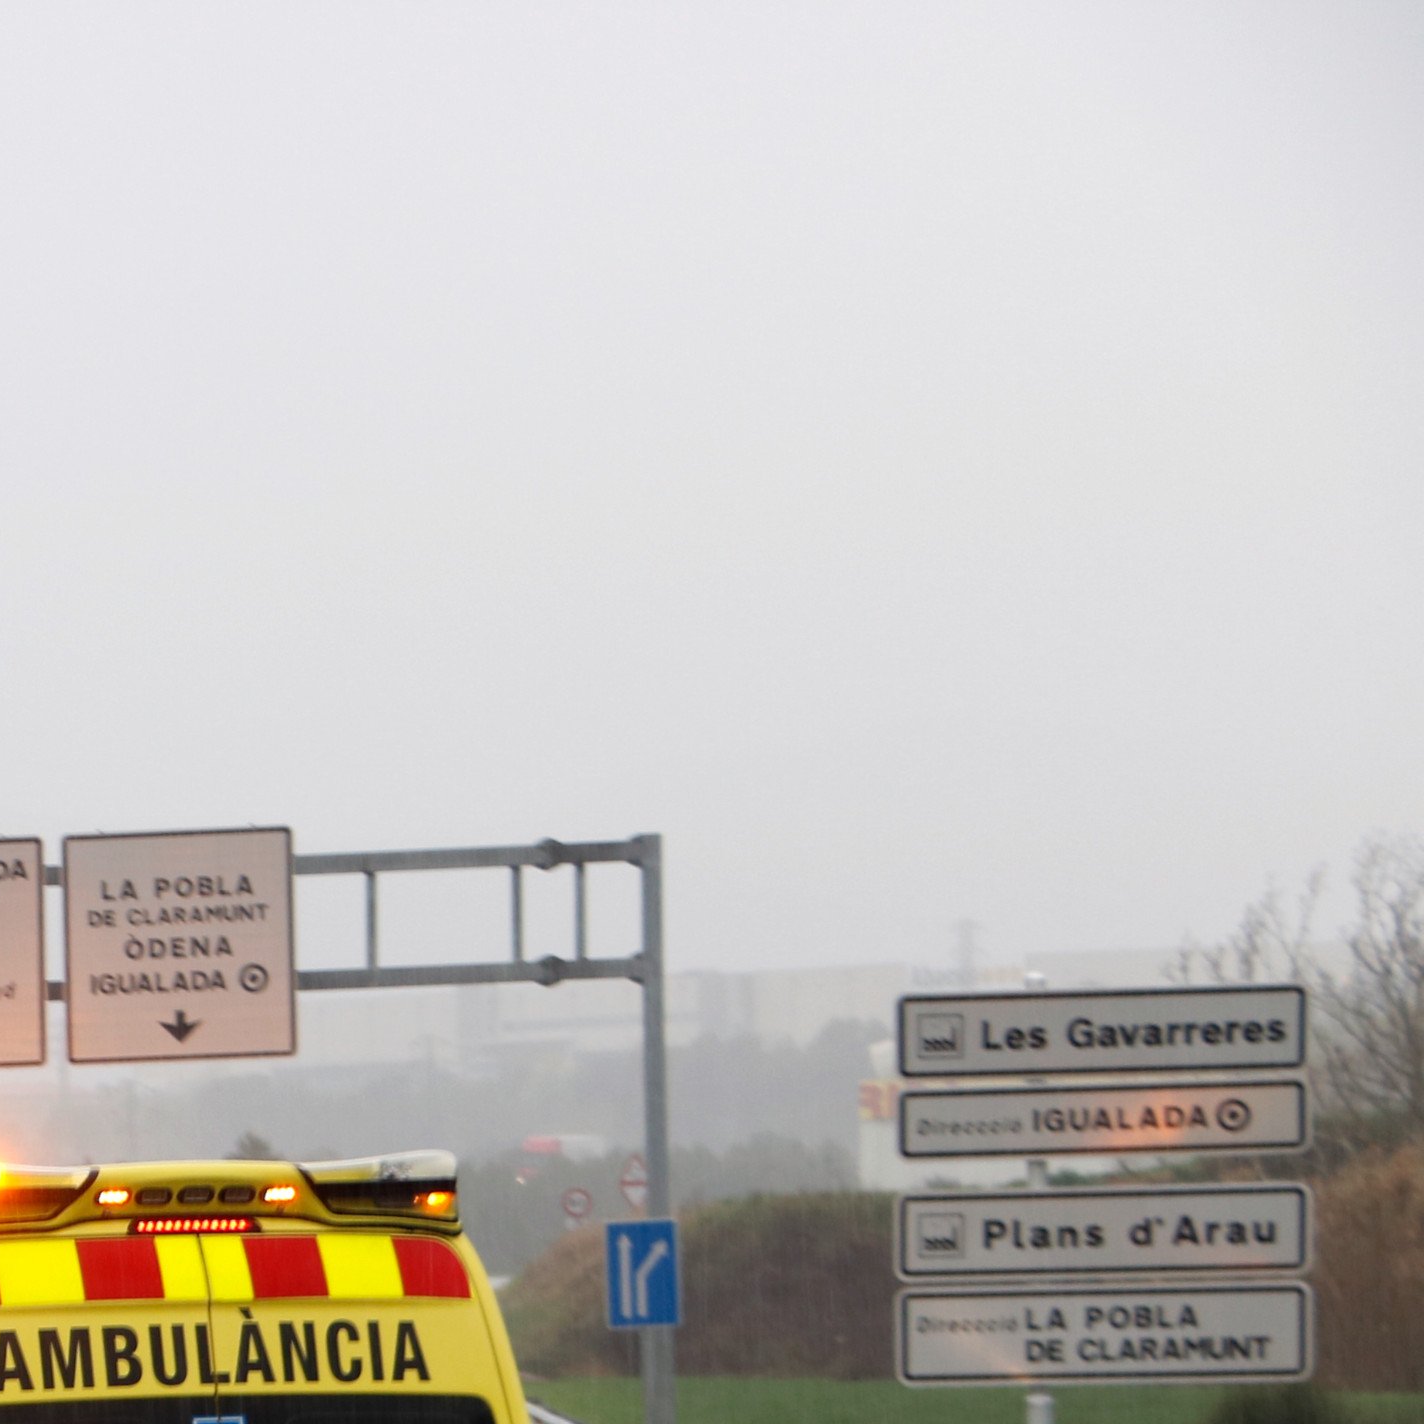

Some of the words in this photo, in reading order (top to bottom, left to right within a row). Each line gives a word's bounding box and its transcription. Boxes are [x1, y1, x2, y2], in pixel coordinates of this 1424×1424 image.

[100, 878, 139, 901] LA
[153, 873, 254, 900] POBLA
[87, 909, 118, 928] DE
[125, 902, 269, 926] CLARAMUNT
[124, 933, 234, 960] ÒDENA
[88, 968, 227, 996] IGUALADA
[980, 1020, 1048, 1051] Les
[1067, 1015, 1287, 1050] Gavarreres
[1032, 1104, 1210, 1134] IGUALADA
[983, 1217, 1106, 1250] Plans
[1129, 1214, 1278, 1248] d'Arau
[1024, 1307, 1067, 1332] LA
[1086, 1303, 1200, 1331] POBLA
[1025, 1339, 1066, 1363] DE
[1077, 1335, 1272, 1363] CLARAMUNT
